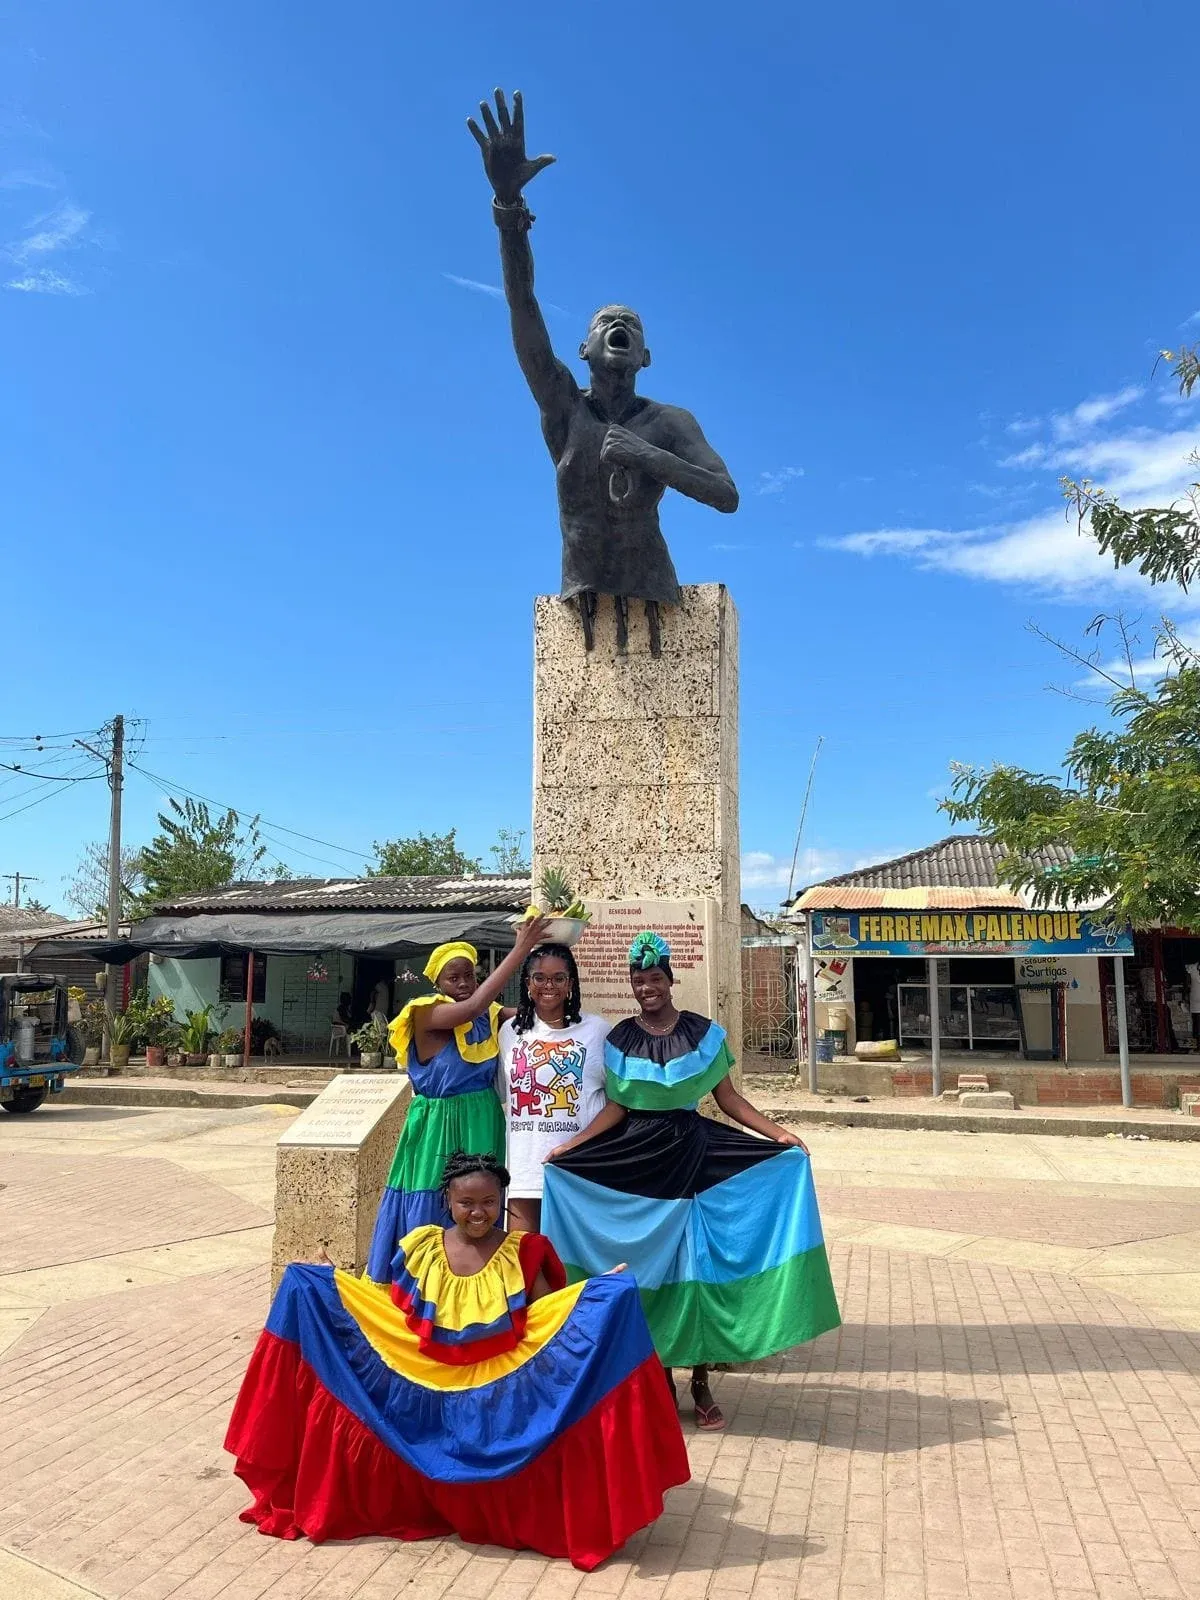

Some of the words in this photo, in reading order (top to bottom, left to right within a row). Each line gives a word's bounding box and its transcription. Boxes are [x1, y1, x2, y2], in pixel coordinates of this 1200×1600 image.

[858, 914, 969, 942] FERREMAX
[972, 913, 1083, 943] PALENQUE
[1026, 965, 1067, 981] Surtigas
